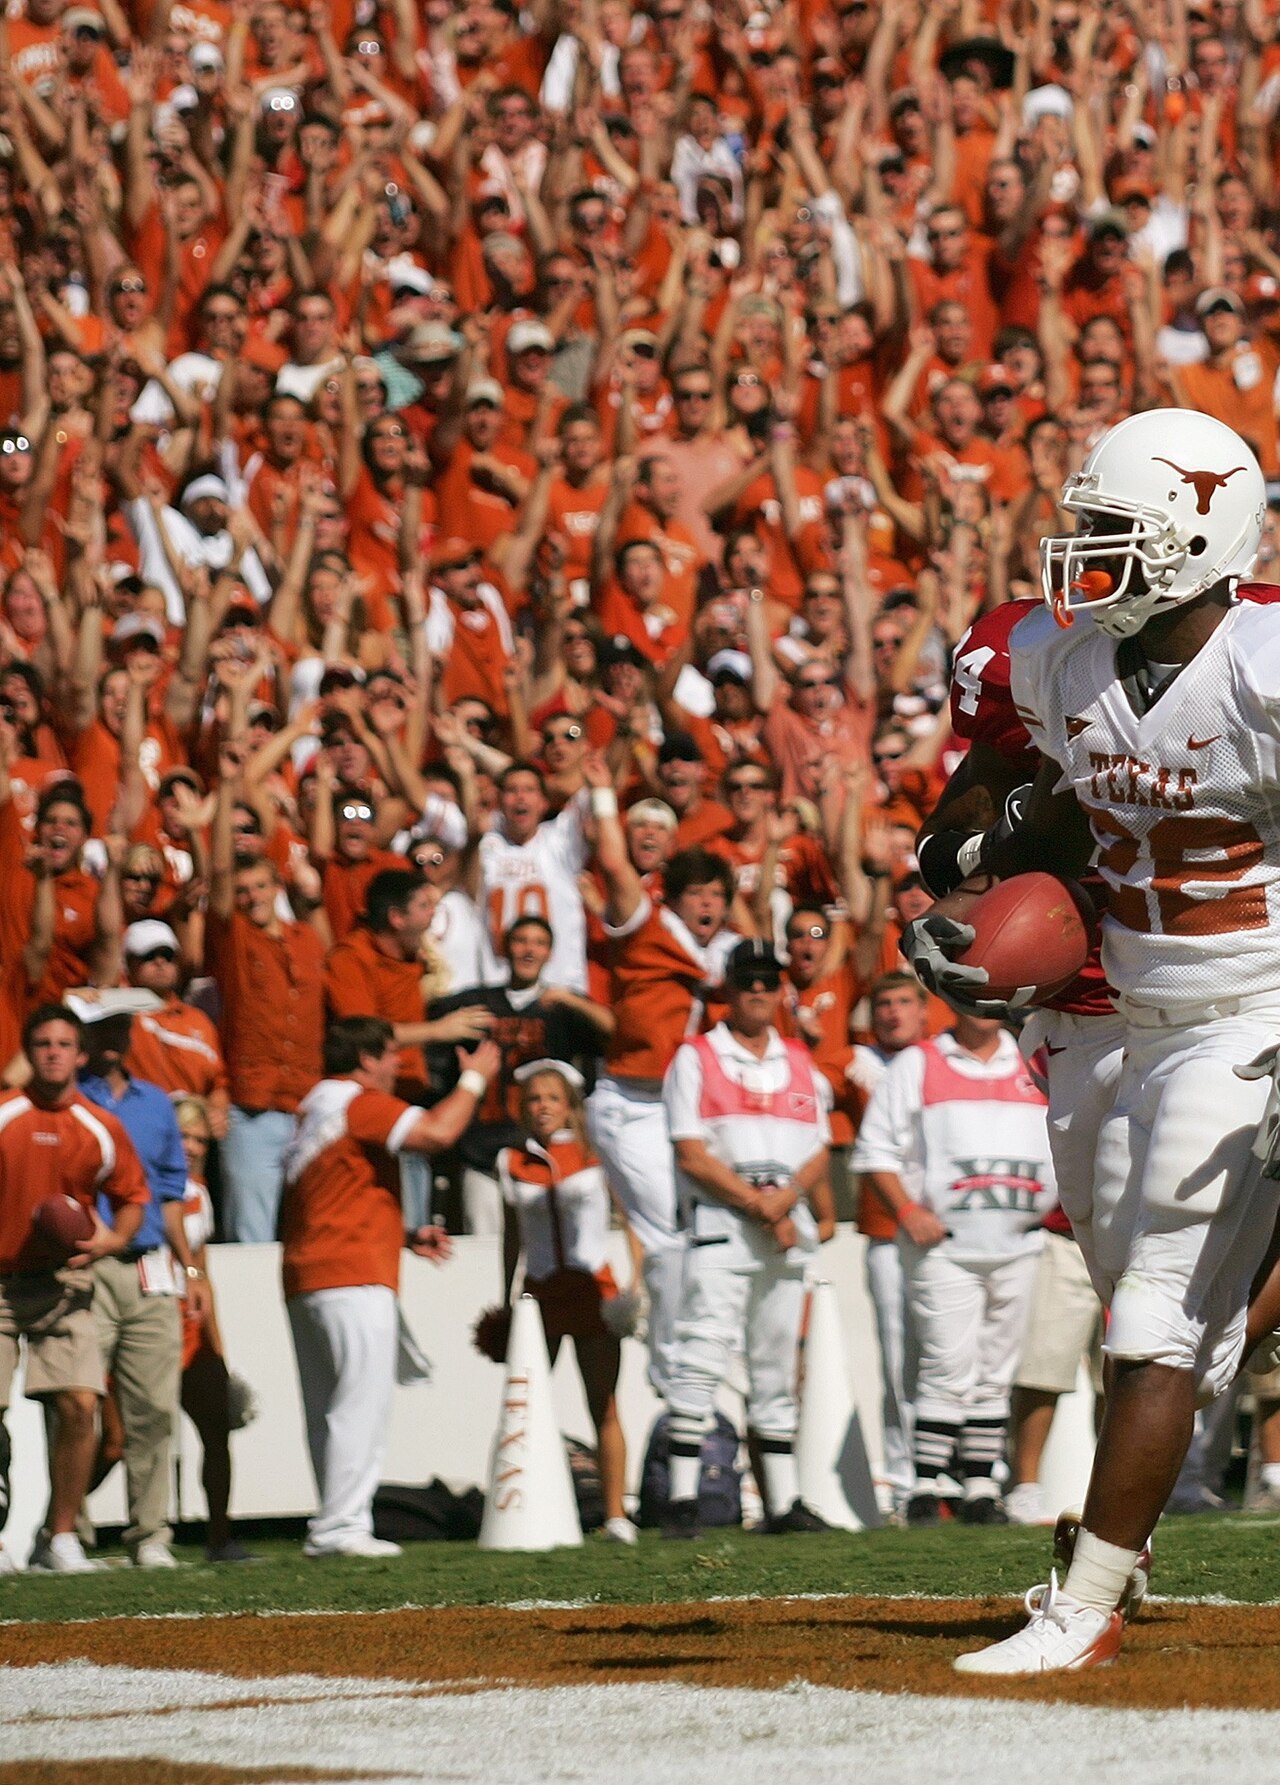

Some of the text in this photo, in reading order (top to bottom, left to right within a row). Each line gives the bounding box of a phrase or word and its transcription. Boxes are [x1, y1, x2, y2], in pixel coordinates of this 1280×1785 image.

[952, 626, 997, 716] 4
[1089, 752, 1198, 811] TEXAS
[1087, 808, 1269, 937] 22
[496, 1367, 530, 1511] TEXAS
